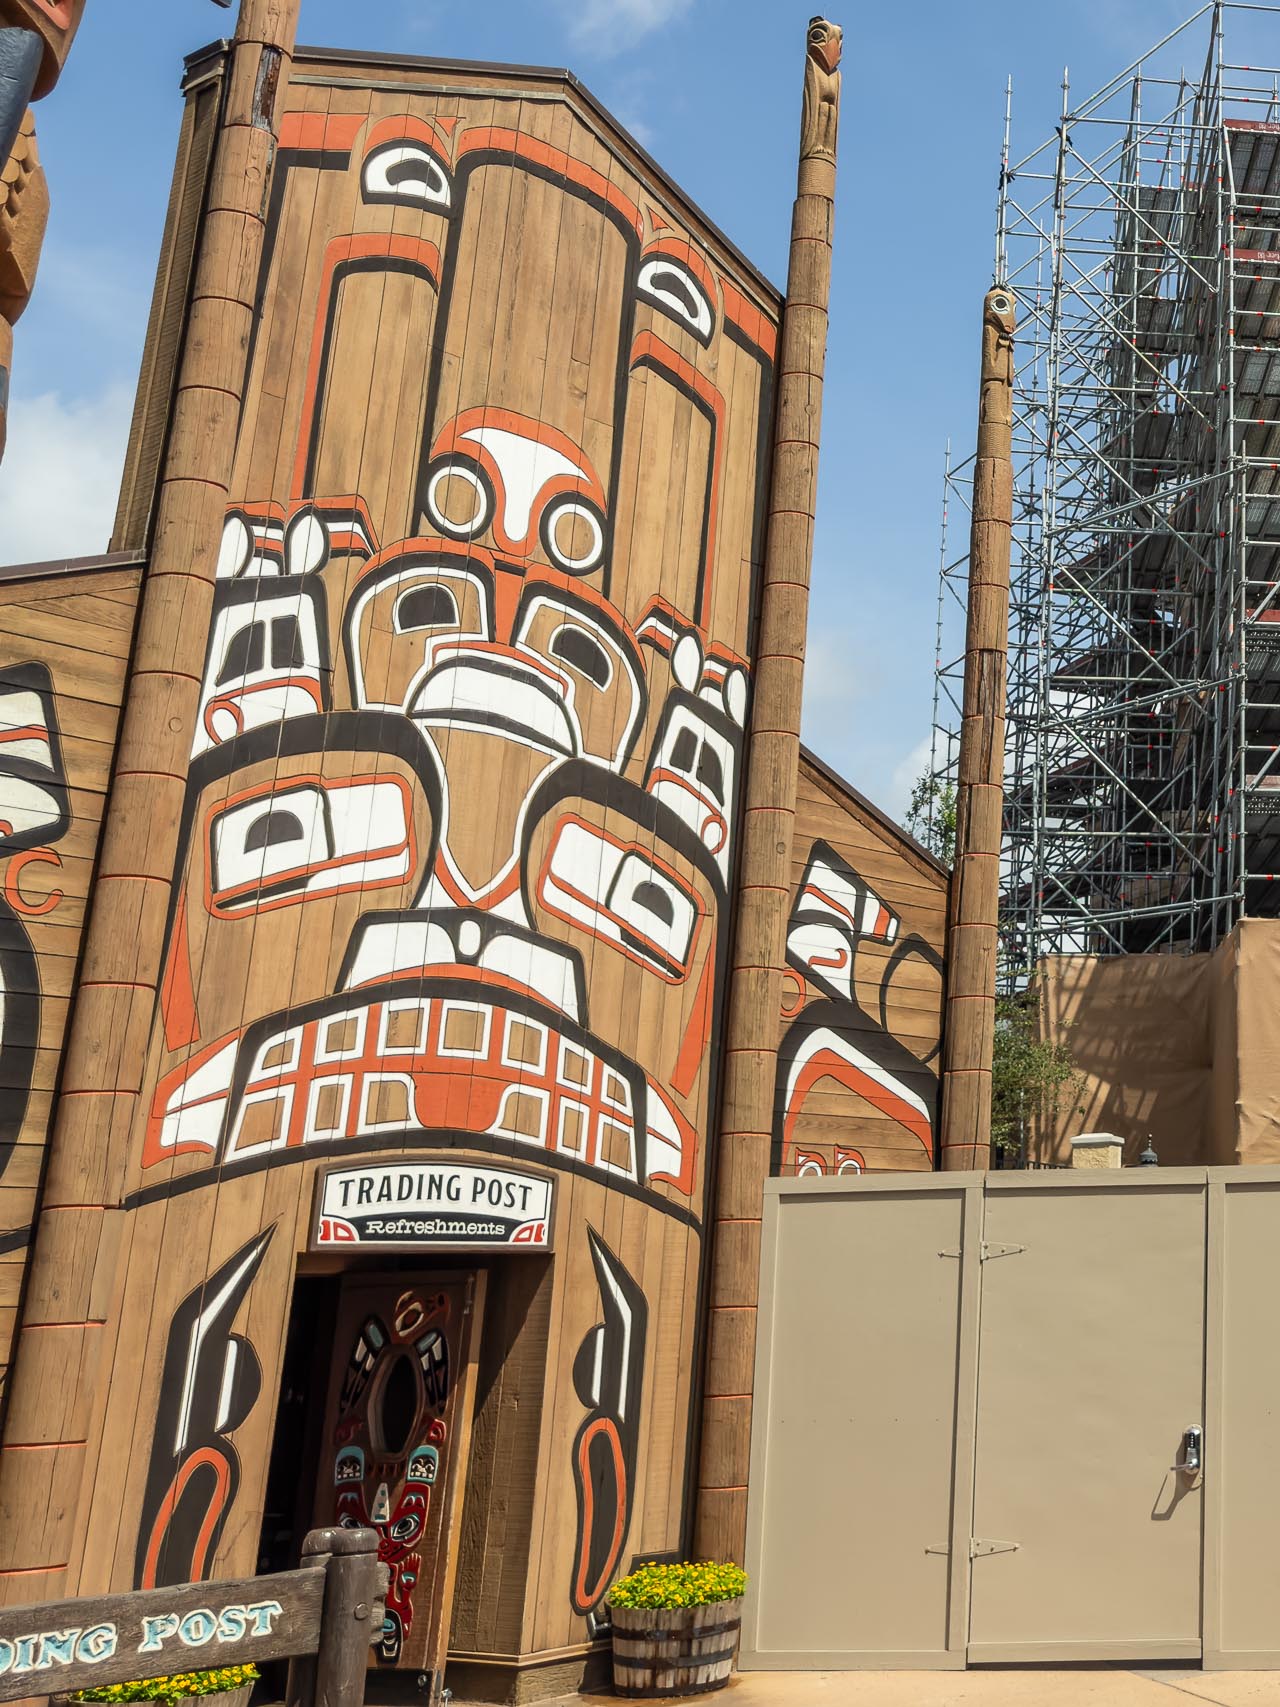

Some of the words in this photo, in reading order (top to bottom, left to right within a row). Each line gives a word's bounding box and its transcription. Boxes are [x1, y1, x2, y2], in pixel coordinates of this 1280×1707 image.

[339, 1174, 461, 1207] TRADING
[472, 1176, 532, 1211] POST
[365, 1219, 505, 1236] Refreshments
[138, 1600, 283, 1652] POST
